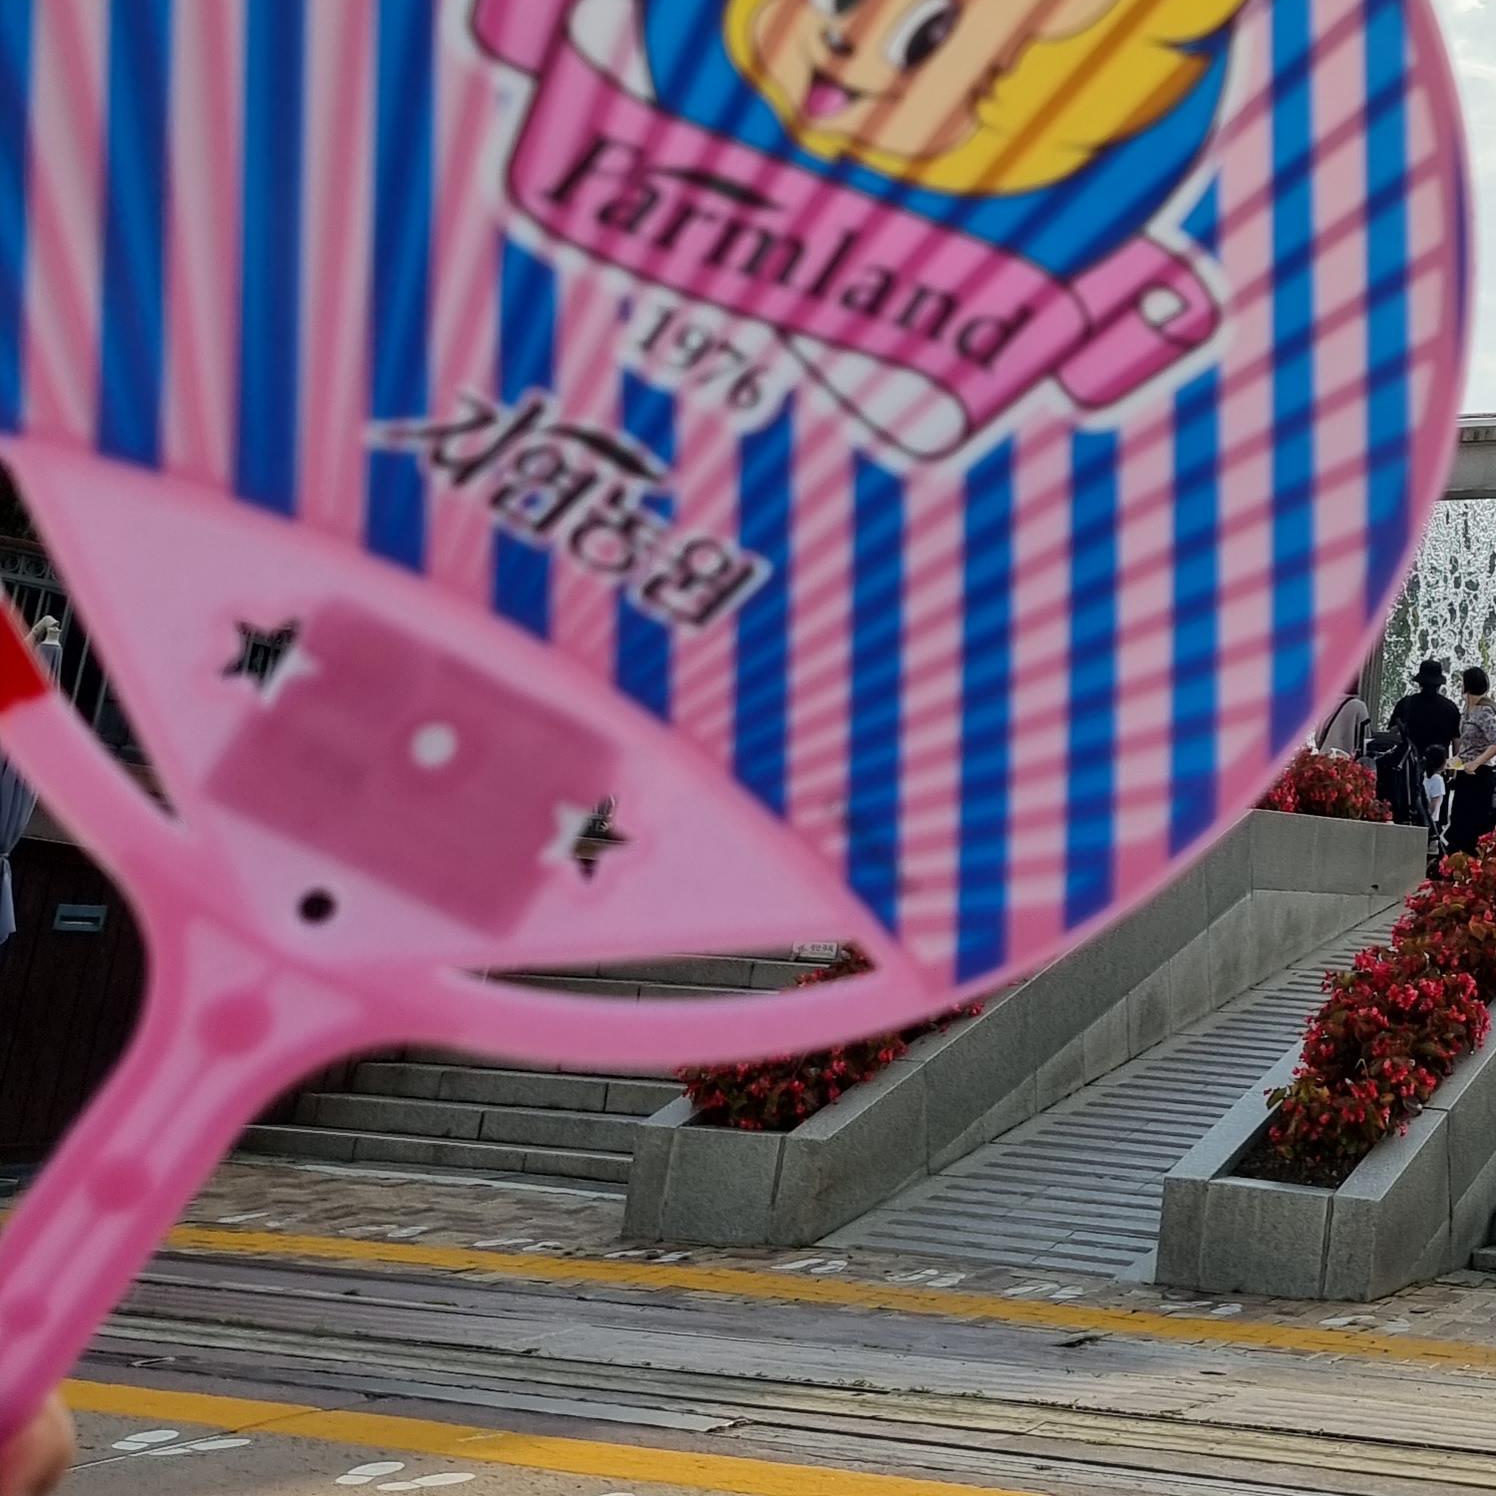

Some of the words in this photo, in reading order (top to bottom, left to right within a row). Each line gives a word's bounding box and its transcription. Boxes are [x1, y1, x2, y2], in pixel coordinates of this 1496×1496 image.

[543, 137, 1034, 370] Farmland
[640, 306, 763, 410] 1976
[383, 390, 757, 626] 자연농원
